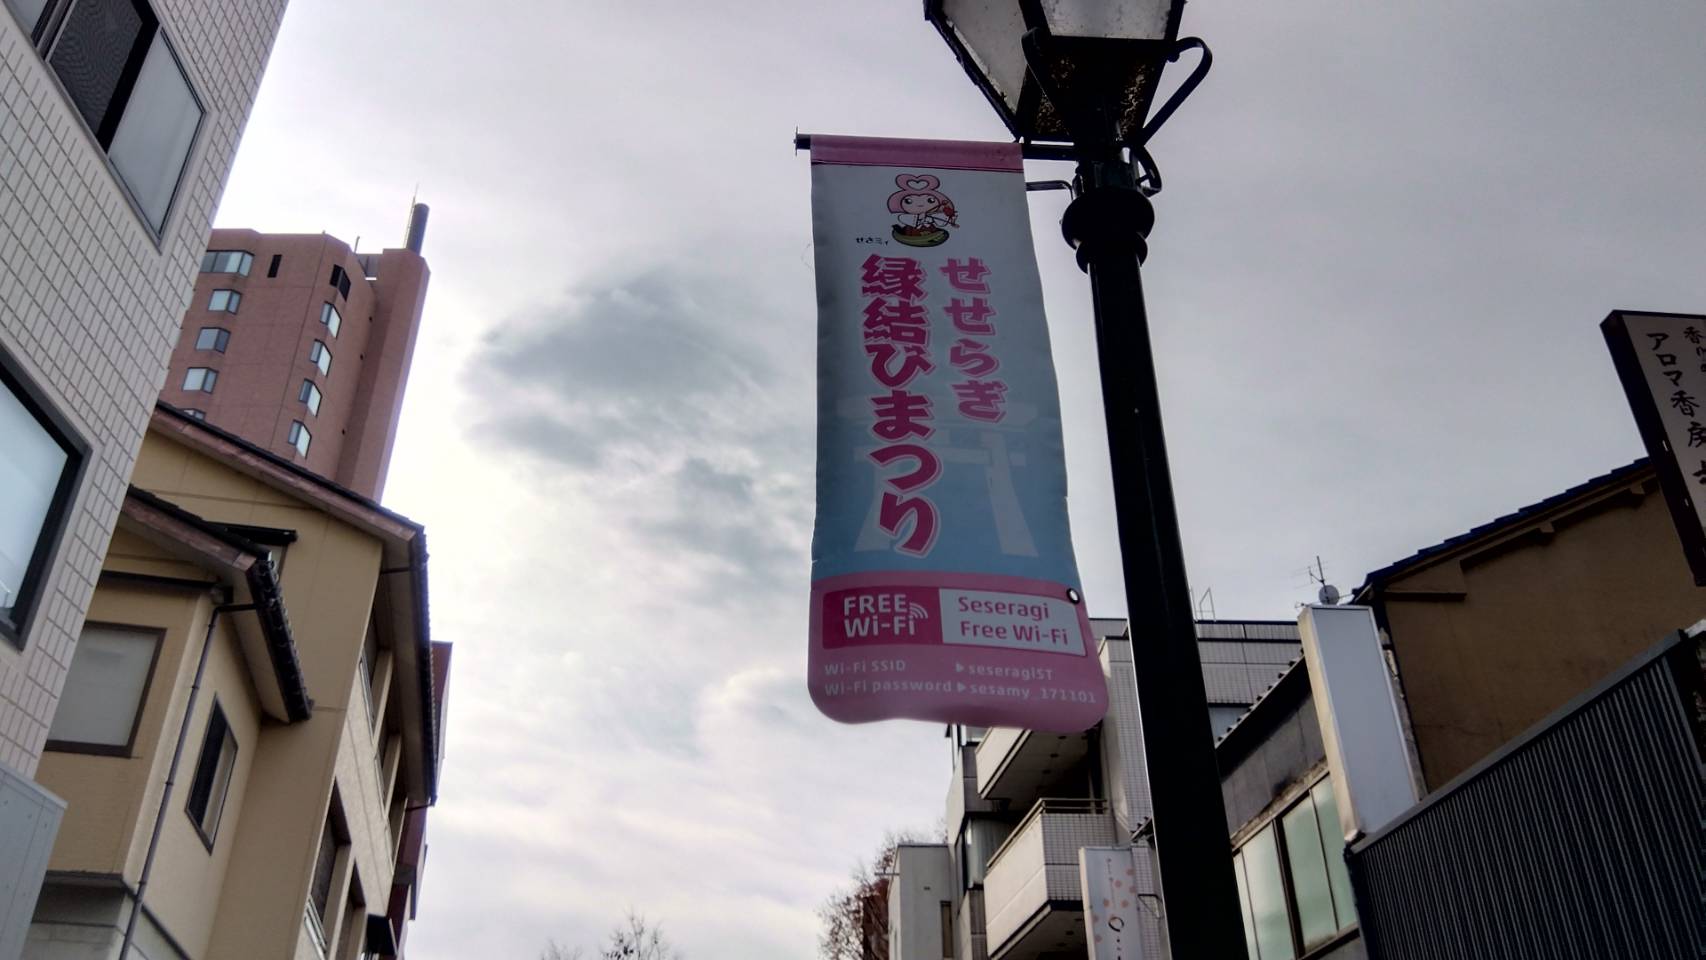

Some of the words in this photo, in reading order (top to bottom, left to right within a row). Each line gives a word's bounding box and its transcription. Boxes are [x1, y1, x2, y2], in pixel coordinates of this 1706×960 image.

[940, 256, 1008, 423] せせらぎ
[861, 253, 942, 557] 縁結びまつり
[843, 594, 907, 616] FREE
[958, 597, 1049, 621] Seseragi
[844, 615, 915, 638] Wi-Fi
[960, 621, 1007, 640] Free
[1012, 624, 1068, 645] Wi-Fi
[824, 662, 866, 675] Wi-Fi
[871, 660, 906, 673] SSID
[824, 680, 866, 696] Wi-Fi
[872, 680, 952, 694] password
